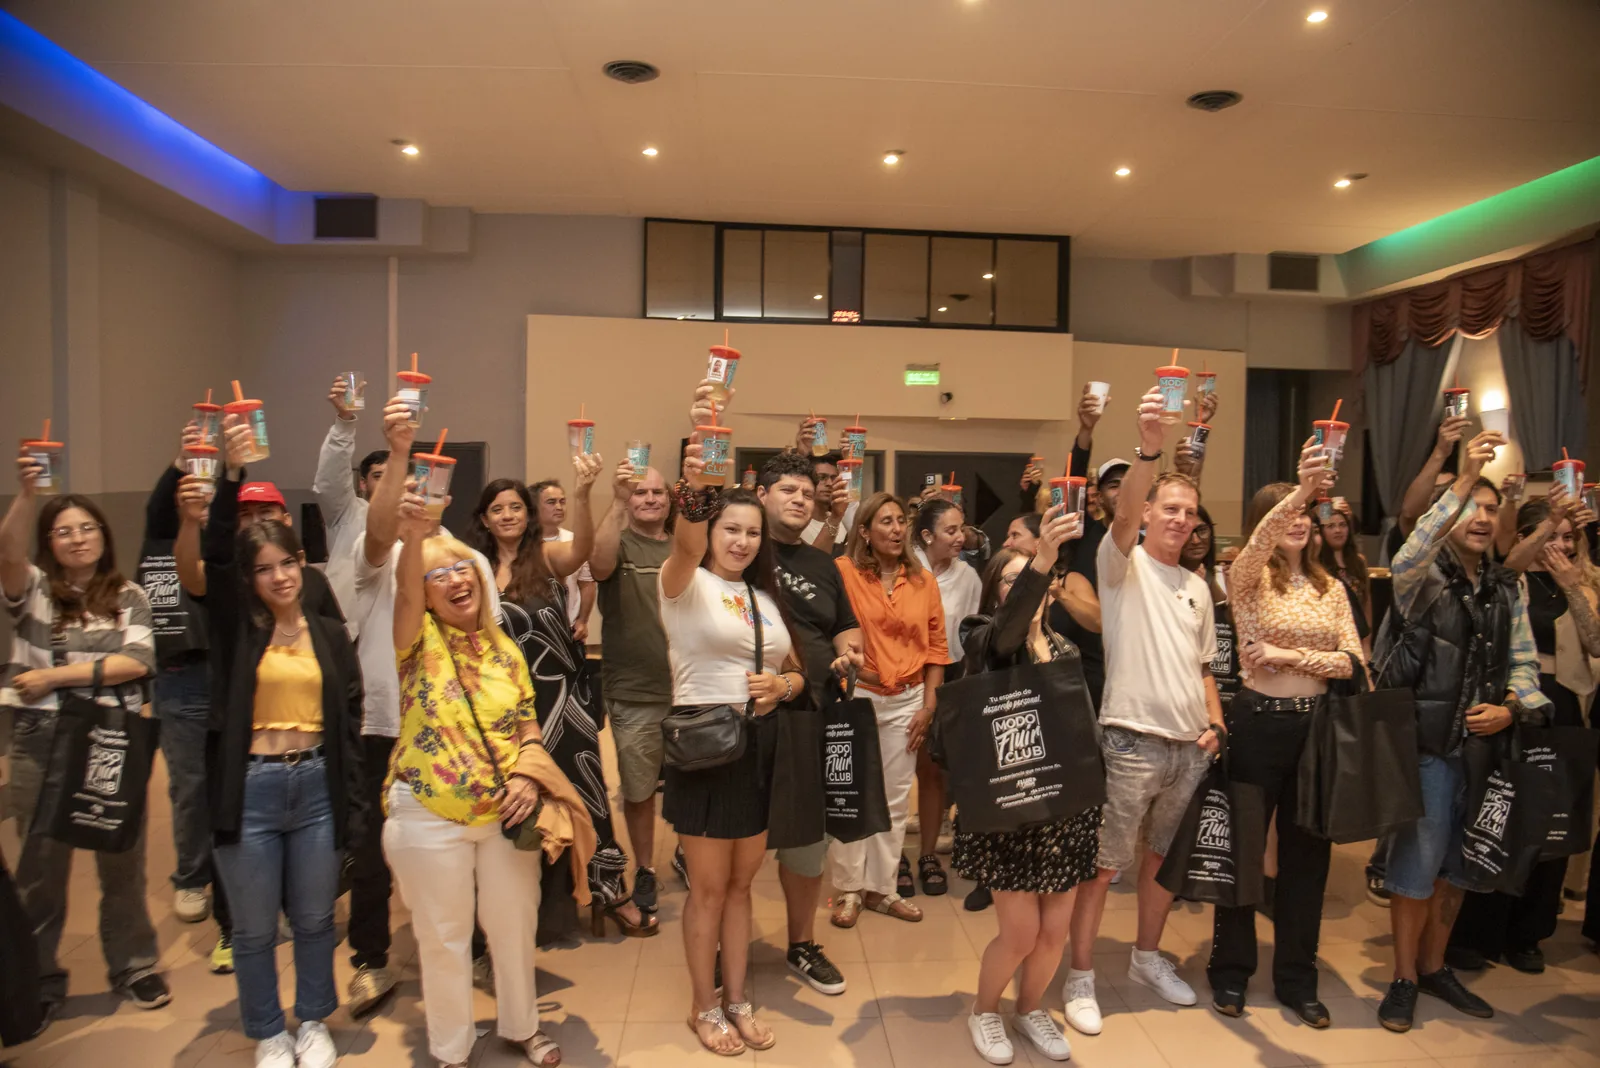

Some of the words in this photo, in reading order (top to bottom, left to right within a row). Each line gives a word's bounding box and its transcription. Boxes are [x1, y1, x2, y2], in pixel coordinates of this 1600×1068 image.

[147, 573, 178, 582] MODO
[150, 596, 177, 605] CLUB
[1208, 661, 1229, 671] CLUB
[999, 690, 1022, 701] espacio
[995, 713, 1036, 732] MODO
[995, 725, 1041, 761] Fluir
[826, 744, 850, 756] MODO
[1004, 745, 1043, 763] CLUB
[825, 753, 852, 778] Fluir
[828, 772, 851, 781] CLUB
[1200, 836, 1230, 849] CLUB
